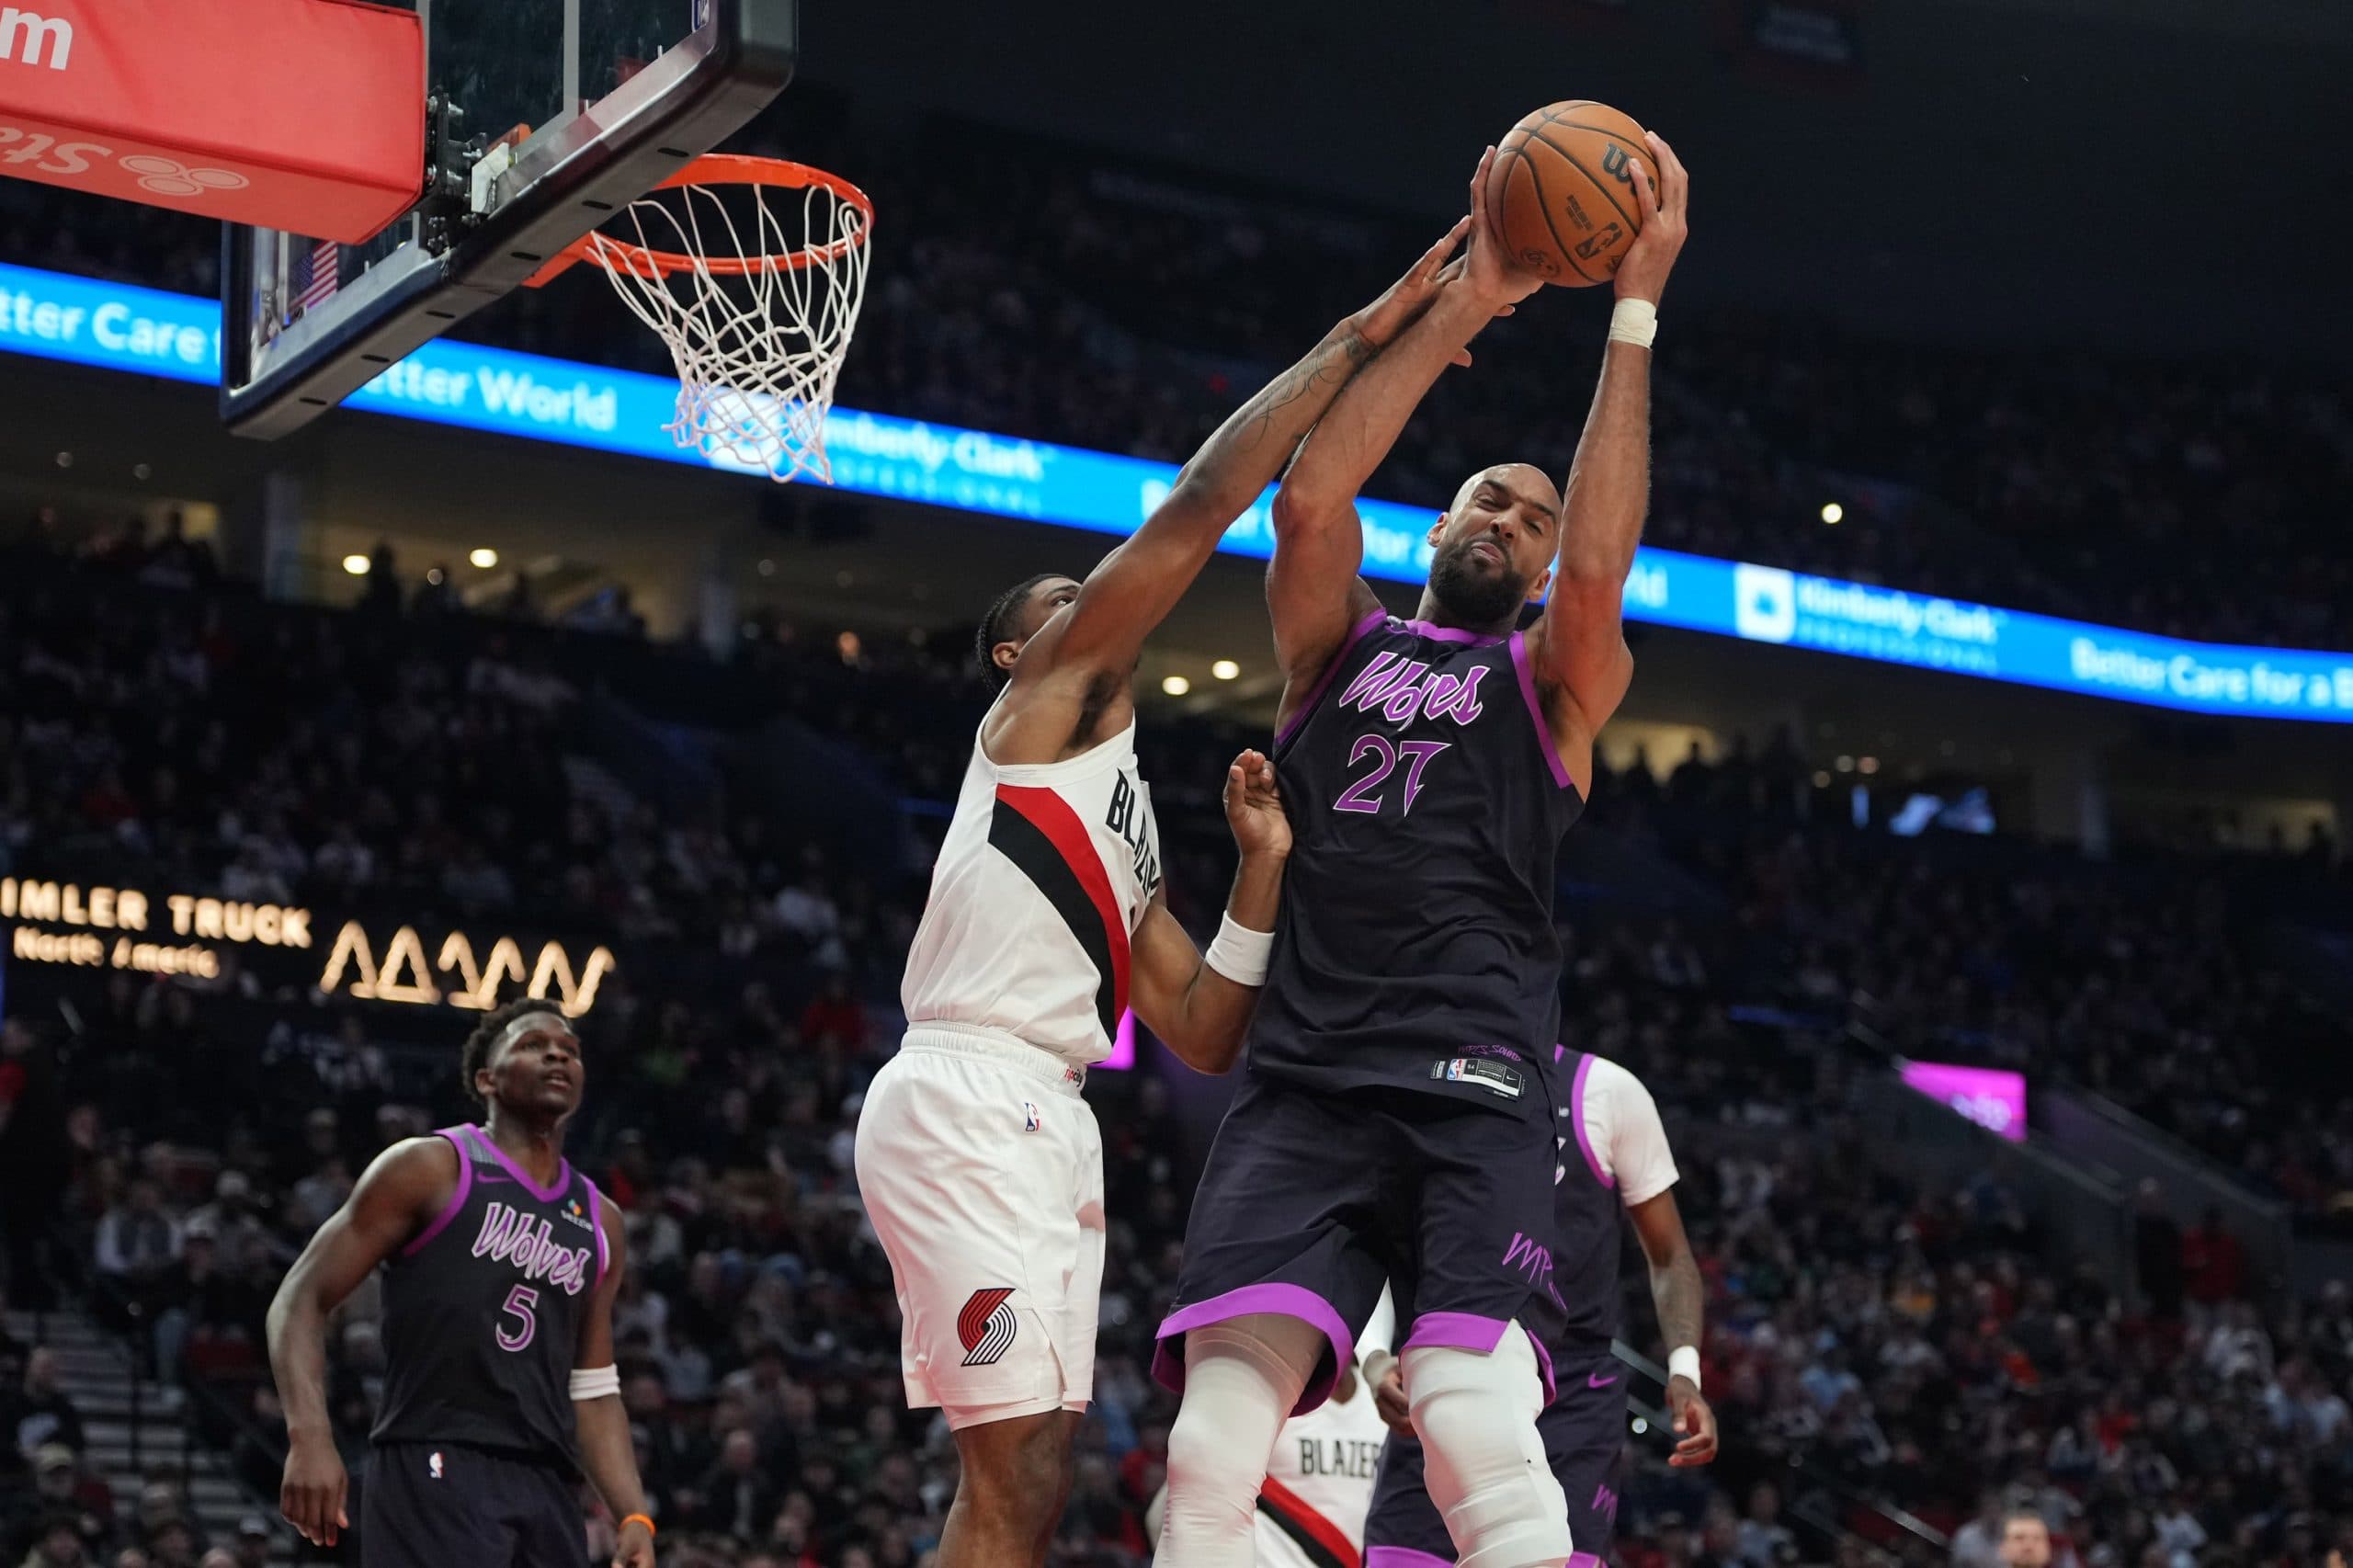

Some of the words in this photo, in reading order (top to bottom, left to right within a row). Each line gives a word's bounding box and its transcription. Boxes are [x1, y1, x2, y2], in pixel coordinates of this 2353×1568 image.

[94, 301, 208, 363] Care
[477, 366, 618, 431] World
[1333, 733, 1452, 817] 27
[167, 894, 313, 949] TRUCK
[472, 1202, 591, 1296] Wolves
[494, 1284, 539, 1352] 5
